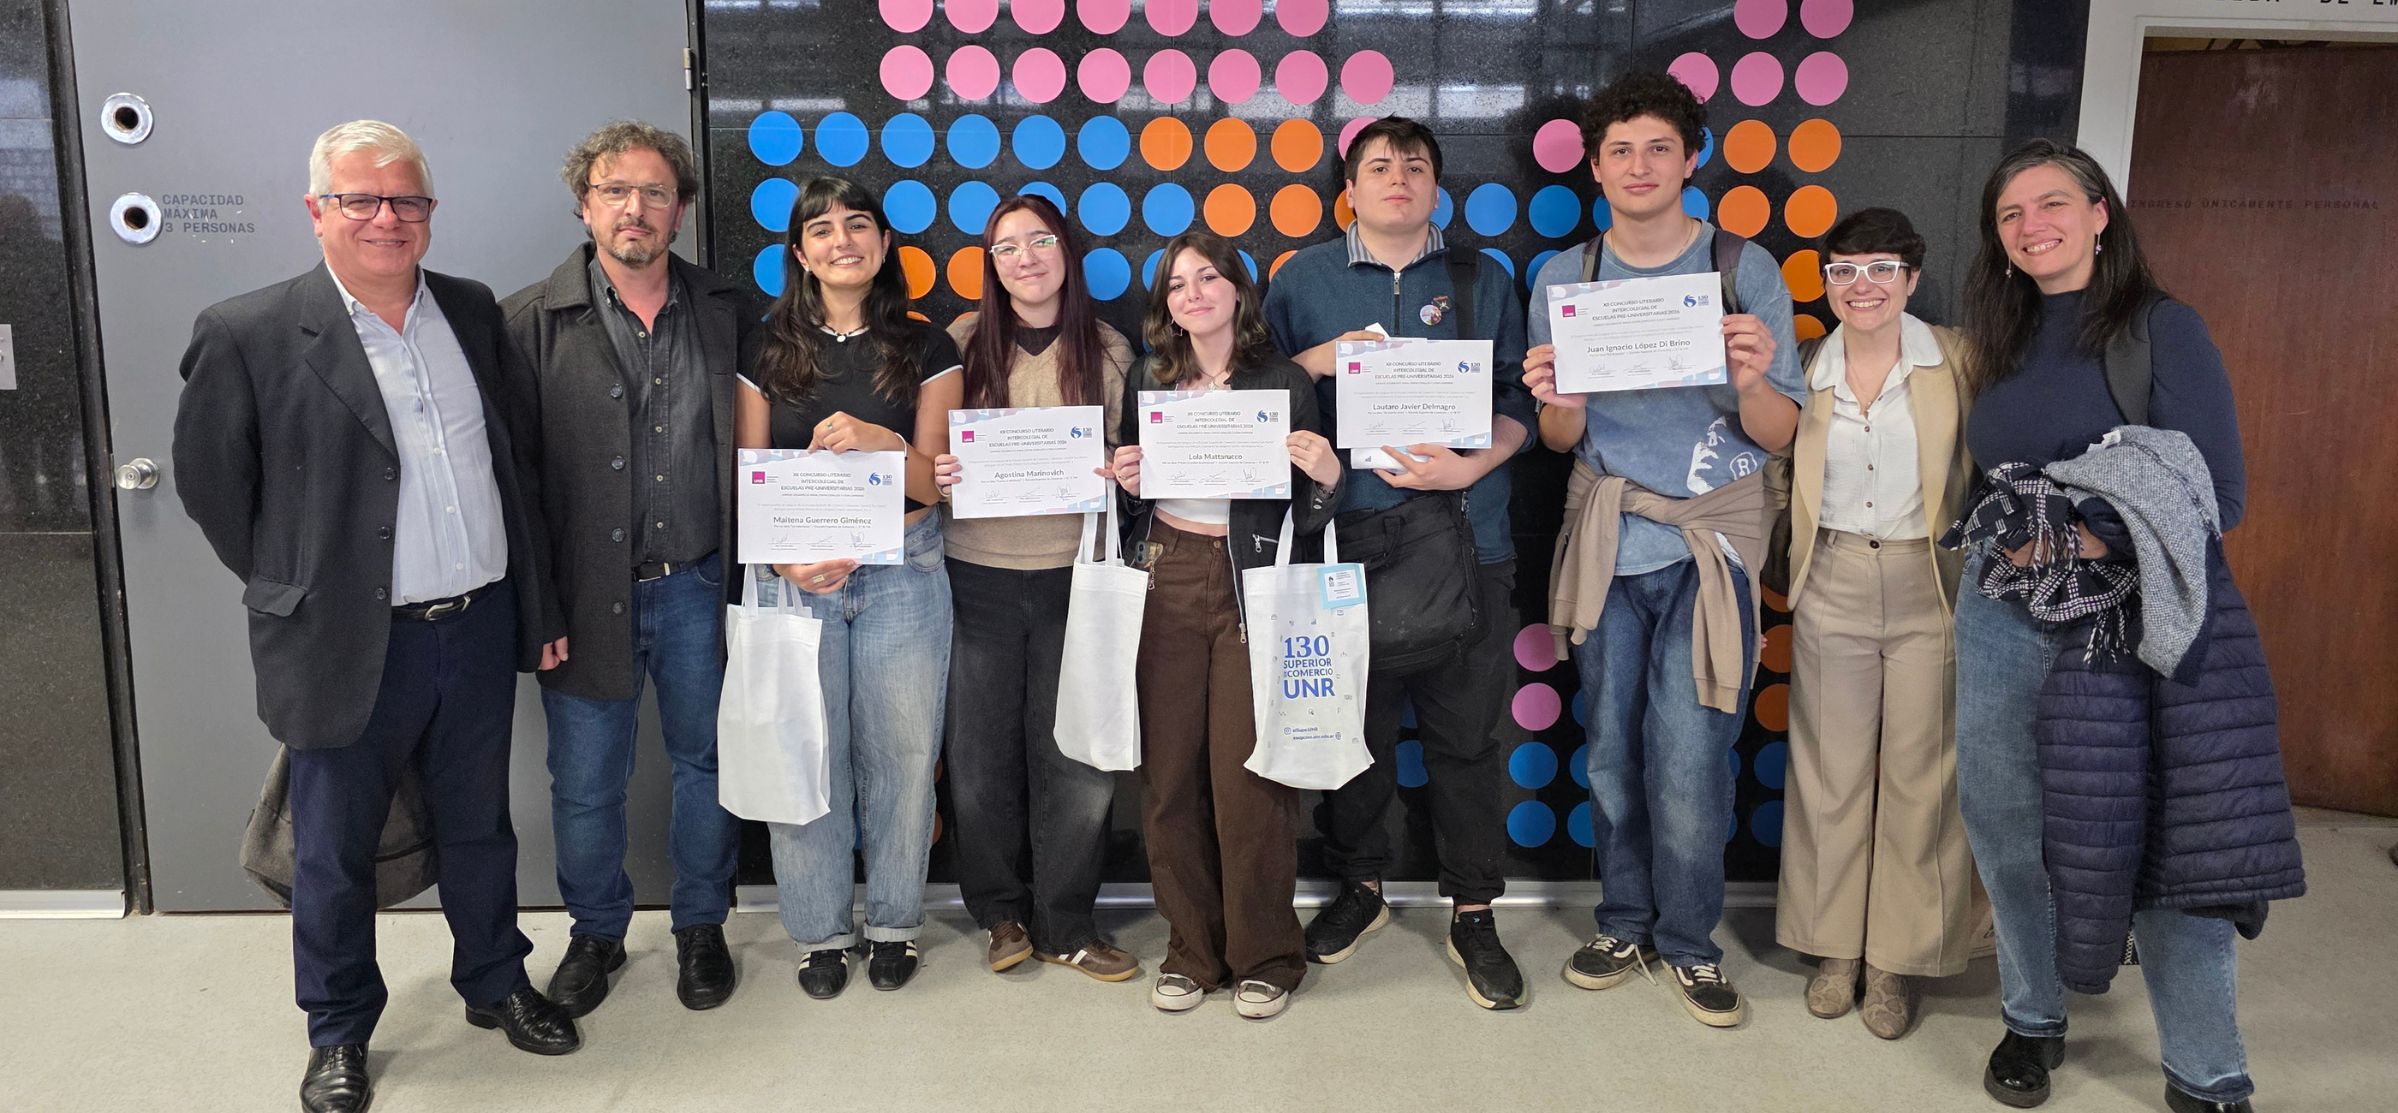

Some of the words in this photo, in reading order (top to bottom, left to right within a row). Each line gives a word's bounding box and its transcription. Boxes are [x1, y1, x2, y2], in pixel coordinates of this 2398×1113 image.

[162, 194, 244, 205] CAPACIDAD
[165, 222, 174, 233] 3
[183, 222, 255, 233] PERSONAS
[1587, 345, 1605, 354] Juan
[1606, 343, 1633, 353] Ignacio
[1634, 342, 1657, 351] López
[1659, 340, 1668, 348] Di
[994, 471, 1025, 479] Agostina
[1026, 469, 1065, 477] Marinovich
[773, 516, 804, 524] Maitena
[1284, 635, 1329, 659] 130
[1283, 658, 1332, 669] SUPERIOR
[1287, 668, 1333, 678] COMERCIO
[1283, 677, 1335, 699] UNR
